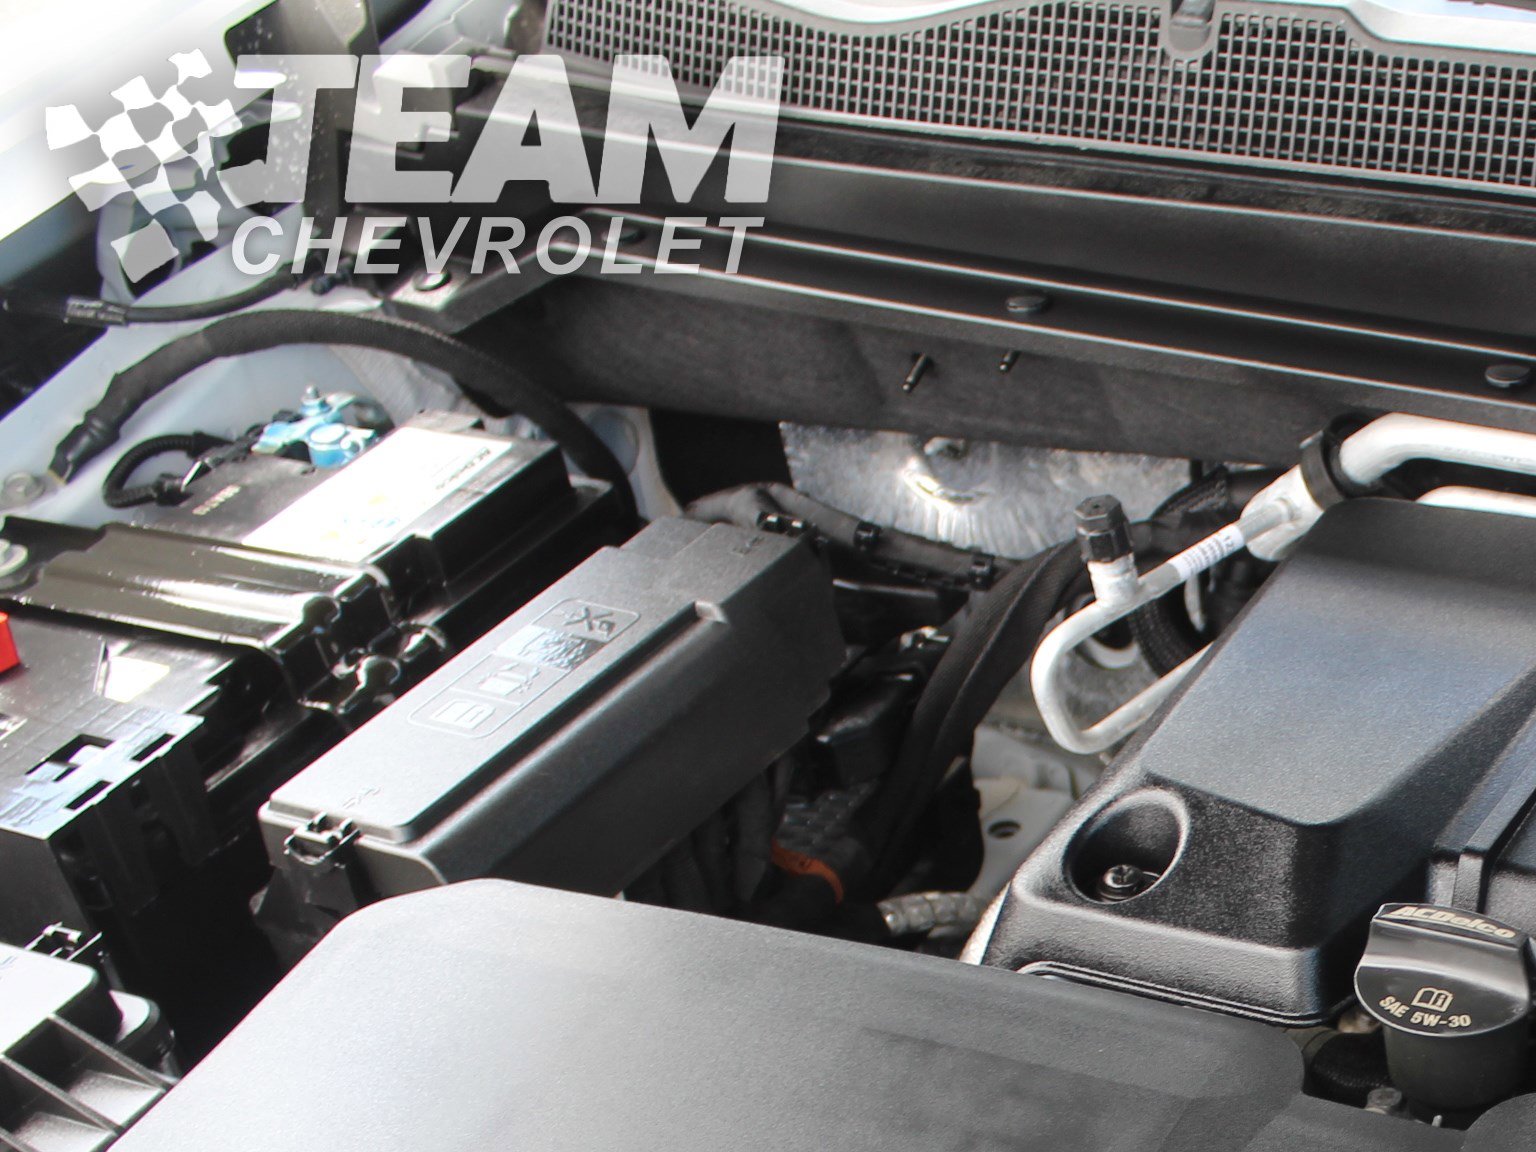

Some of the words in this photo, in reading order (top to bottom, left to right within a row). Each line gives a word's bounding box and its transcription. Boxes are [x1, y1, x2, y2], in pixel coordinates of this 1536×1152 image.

[1381, 905, 1516, 938] ACDelco
[1379, 996, 1410, 1017] SAE
[1410, 1011, 1472, 1028] 5W-30
